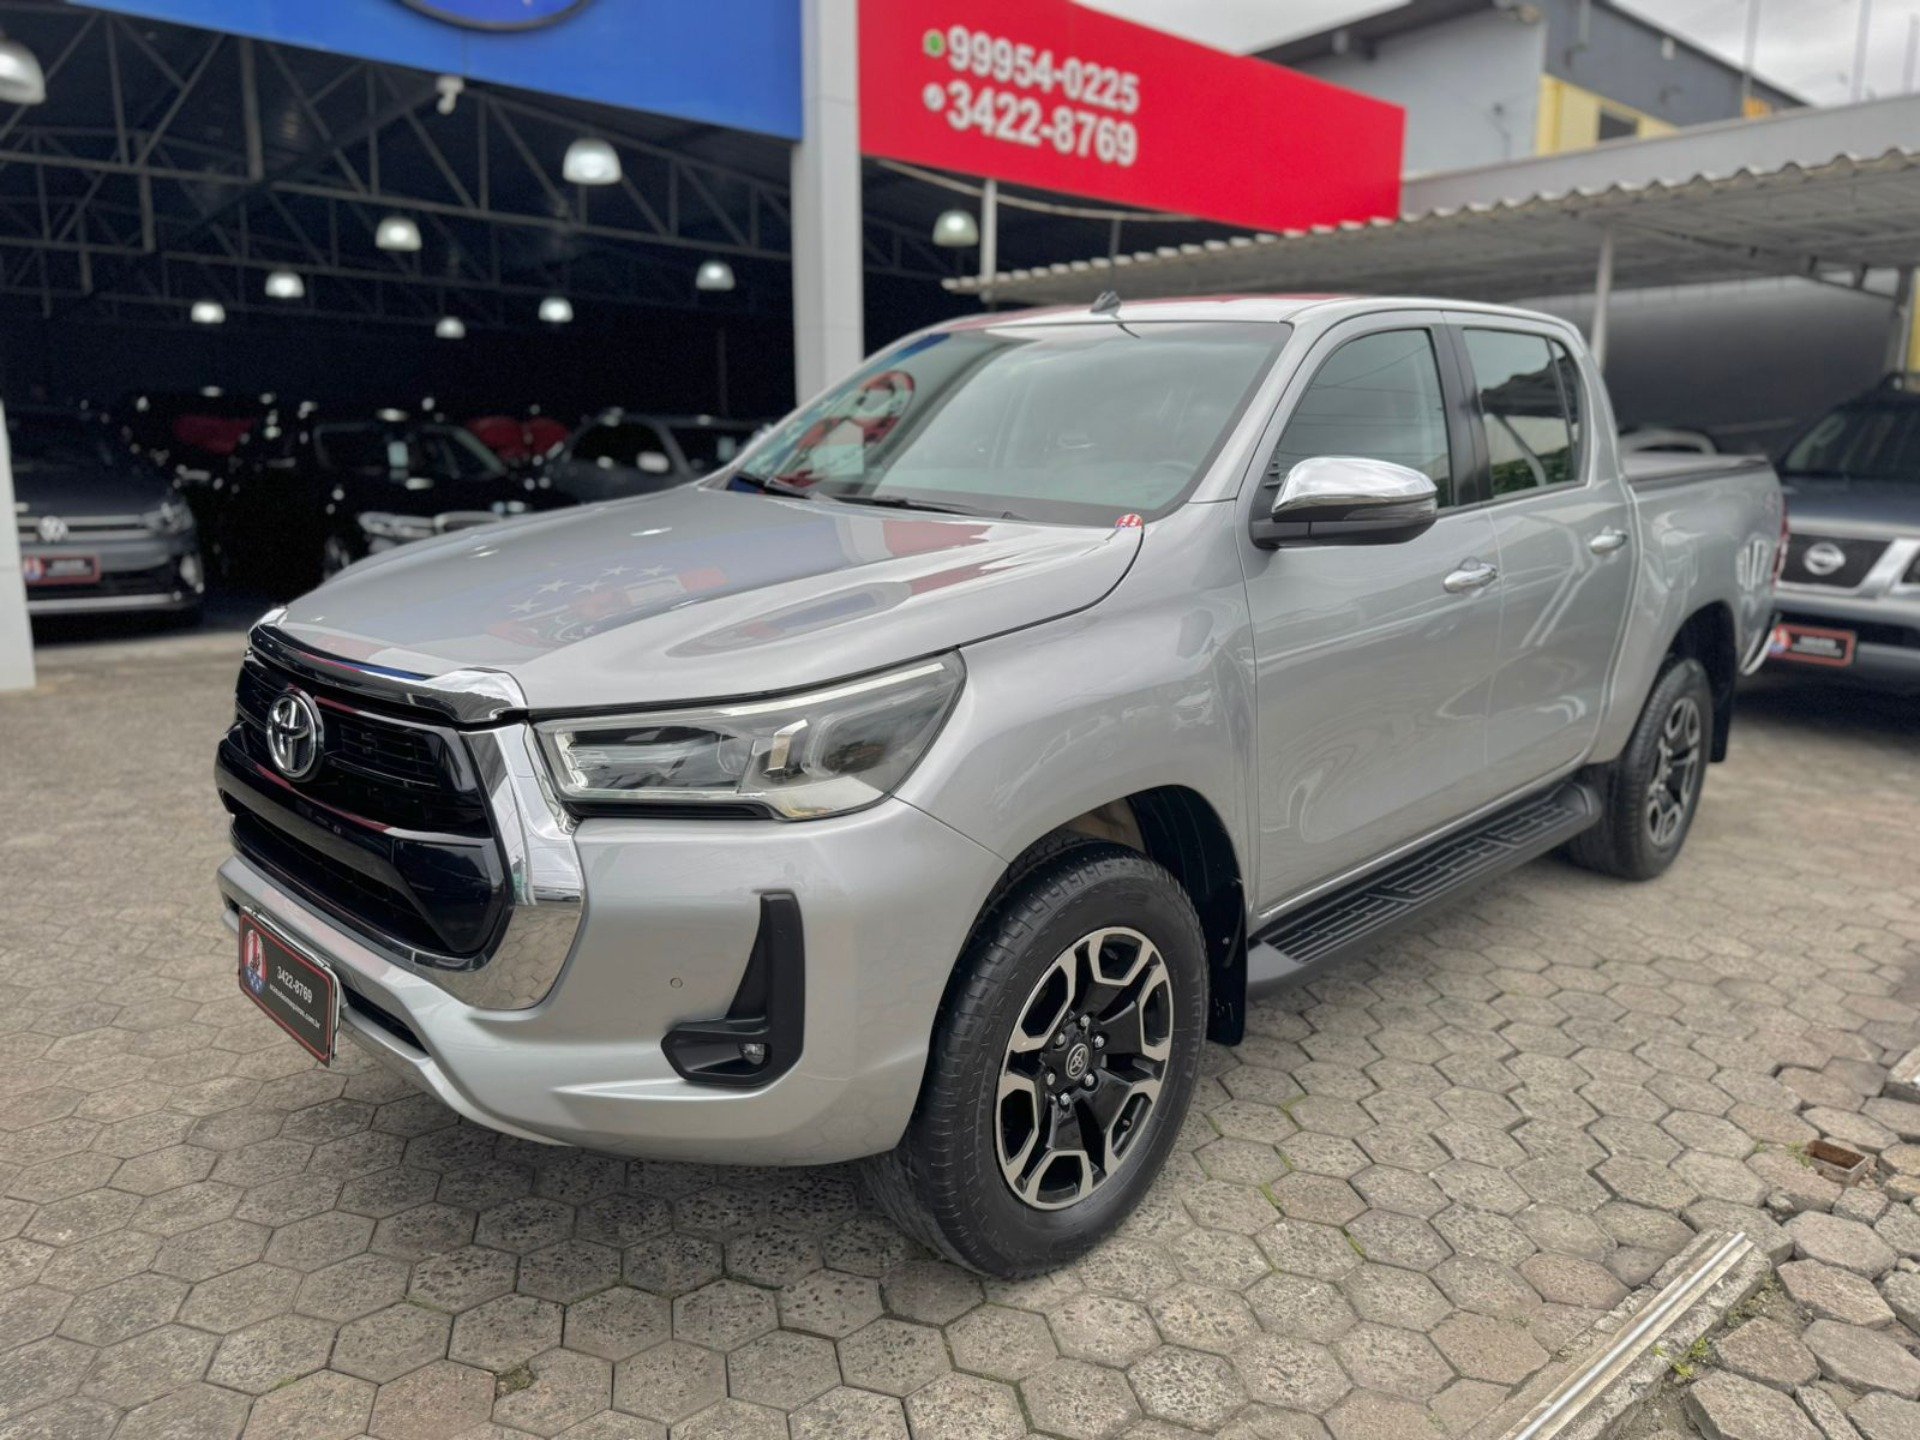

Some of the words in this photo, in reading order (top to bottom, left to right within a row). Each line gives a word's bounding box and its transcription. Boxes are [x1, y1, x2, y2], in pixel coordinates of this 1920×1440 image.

[948, 26, 1139, 113] 99954-0225
[947, 81, 1137, 166] 3422-8769
[278, 966, 313, 1003] 3422-8769
